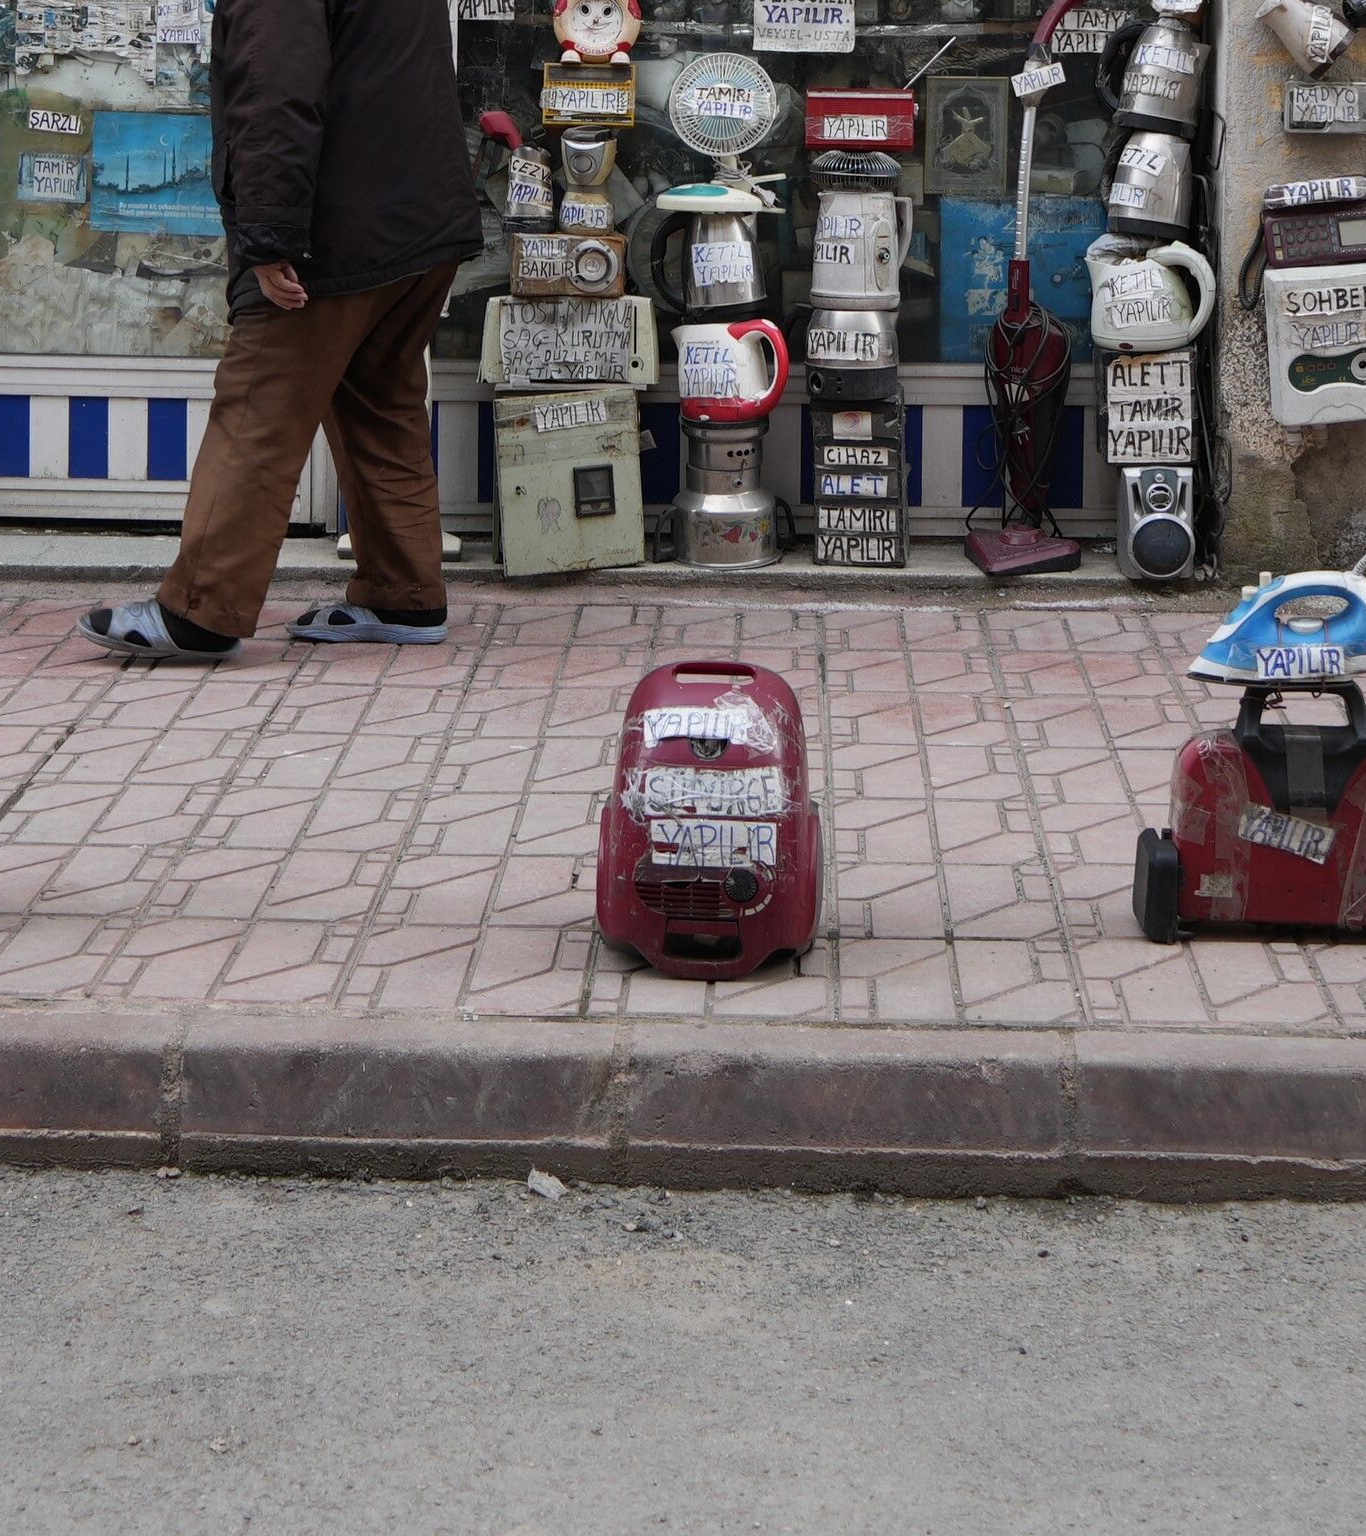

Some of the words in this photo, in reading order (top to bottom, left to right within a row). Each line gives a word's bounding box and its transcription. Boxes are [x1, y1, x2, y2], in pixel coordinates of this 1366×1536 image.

[757, 28, 803, 40] VEYSEL
[1014, 69, 1062, 90] YAPILIR
[1296, 88, 1355, 105] RADYO
[825, 117, 887, 137] YAPILIR
[36, 158, 75, 177] TAMİR
[1284, 181, 1352, 204] YAPILIR
[693, 244, 750, 264] KETİL
[520, 260, 573, 278] BAKILIR
[695, 264, 752, 286] YAPILIR
[1114, 299, 1171, 323] YAPILIR
[684, 345, 733, 369] KETİL
[565, 365, 624, 379] YAPILIR
[825, 448, 885, 465] CİHAZ
[822, 475, 886, 495] ALET
[819, 535, 895, 561] YAPILIR
[1257, 648, 1343, 677] YAPILIR
[1243, 807, 1332, 855] YAPILIR
[658, 823, 775, 866] YAPILIR
